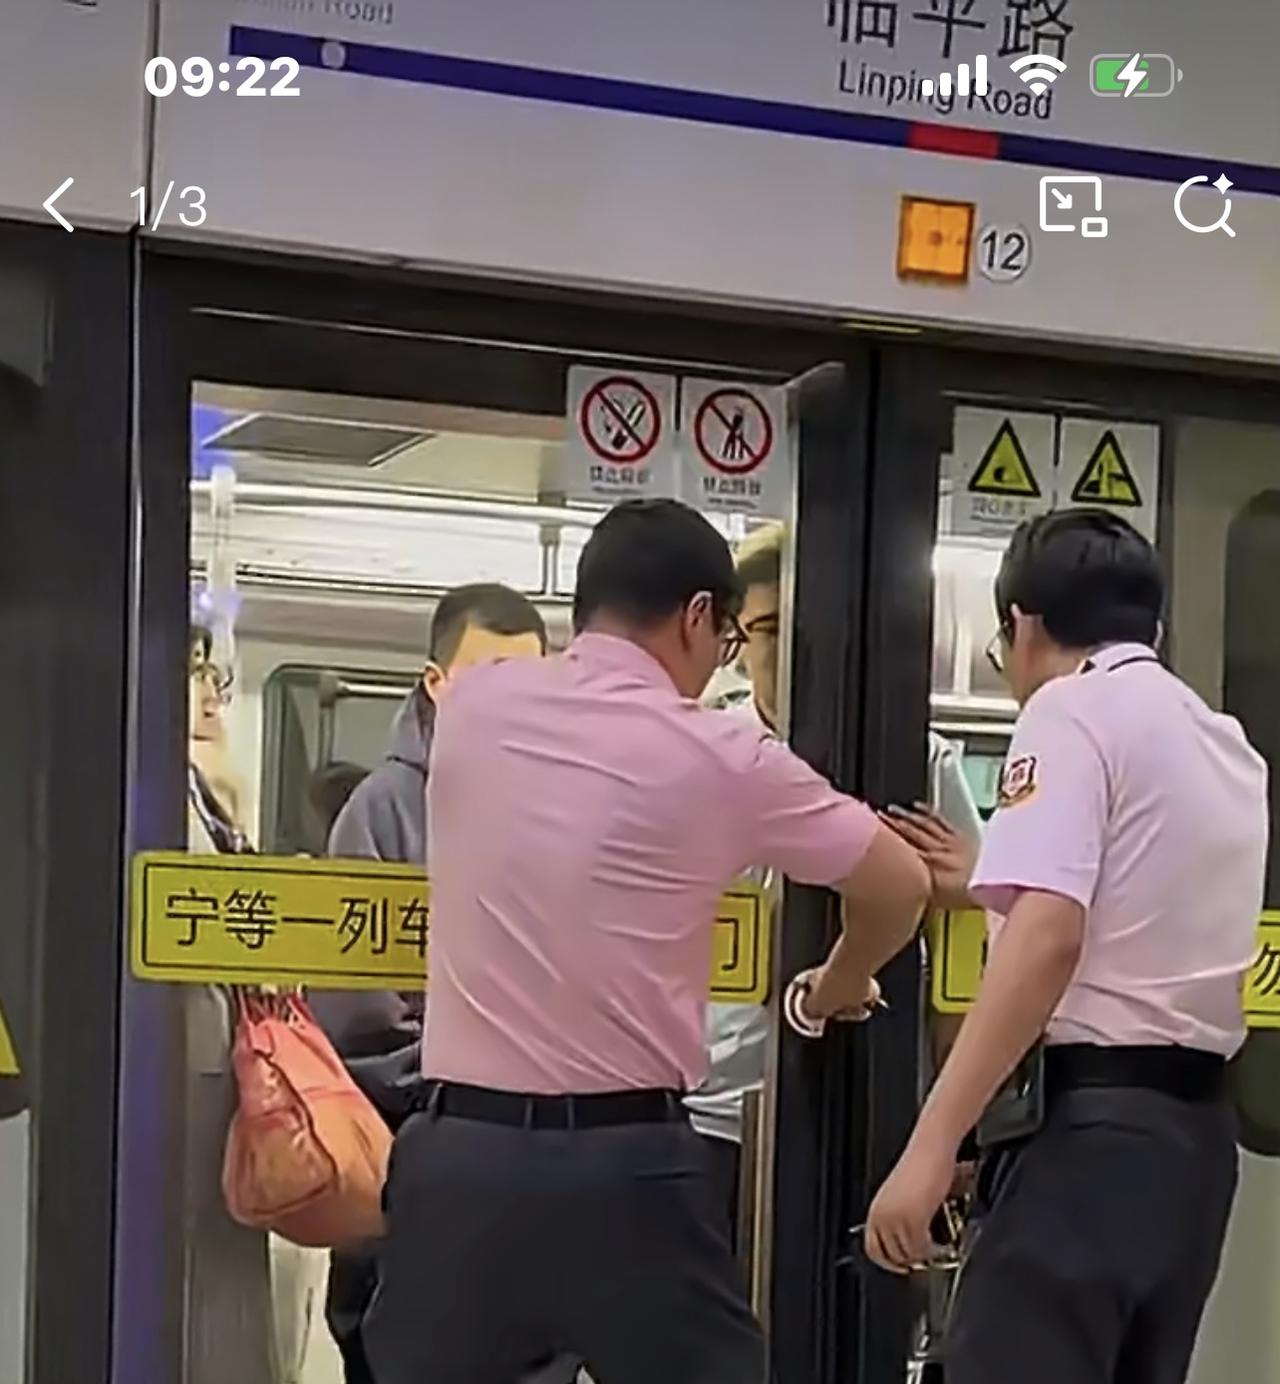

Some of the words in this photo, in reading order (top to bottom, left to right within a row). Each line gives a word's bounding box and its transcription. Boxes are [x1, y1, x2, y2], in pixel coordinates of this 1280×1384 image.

[967, 78, 1053, 120] Road
[981, 228, 1027, 272] 12
[165, 887, 429, 958] 宁等一列车
